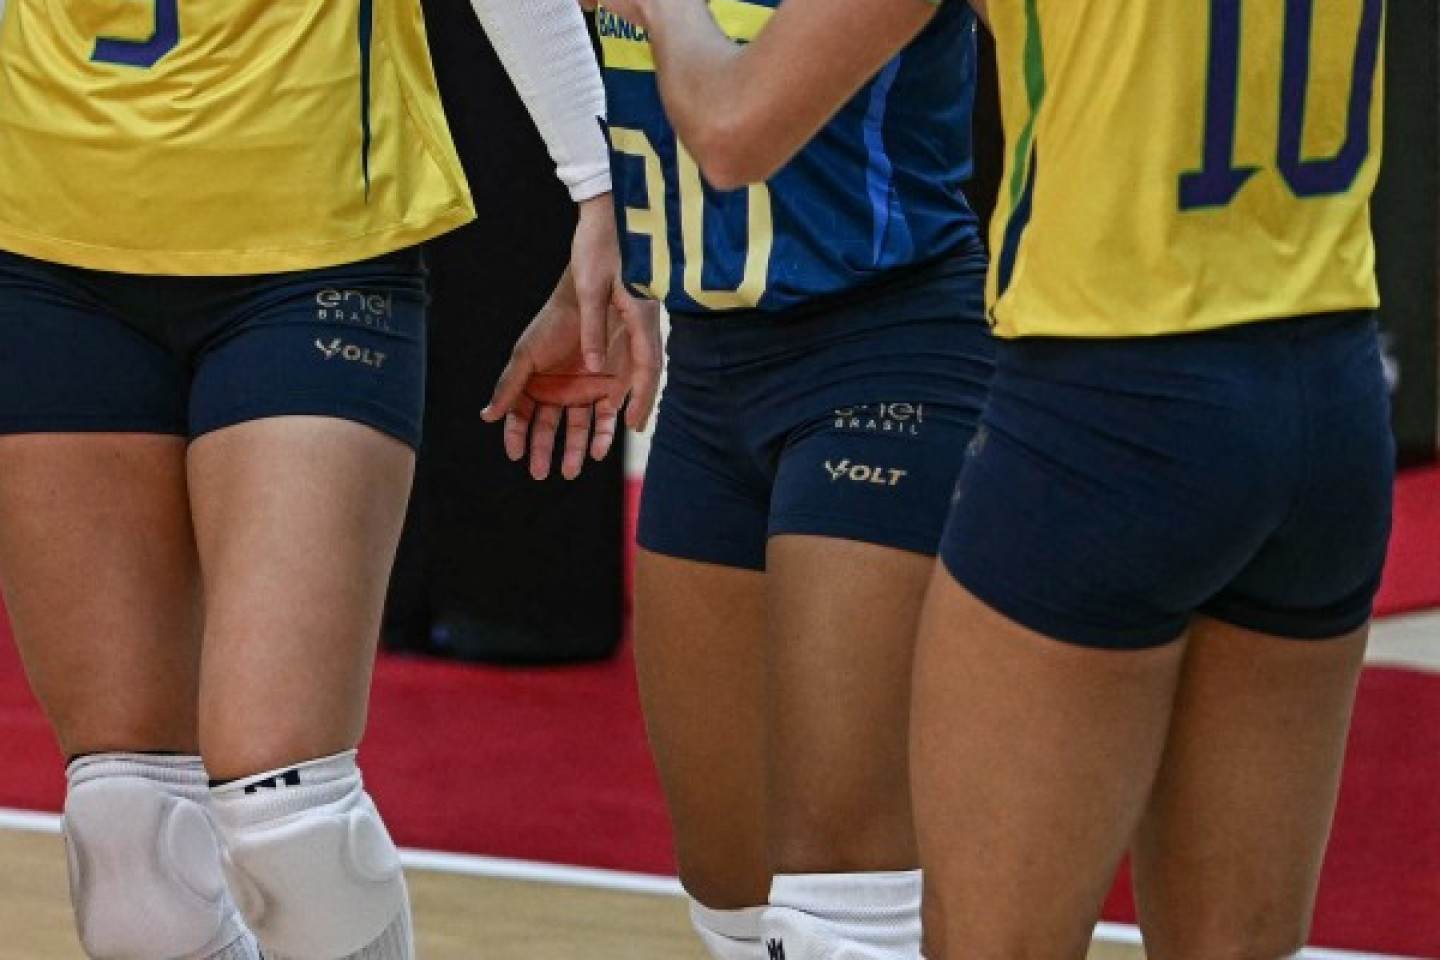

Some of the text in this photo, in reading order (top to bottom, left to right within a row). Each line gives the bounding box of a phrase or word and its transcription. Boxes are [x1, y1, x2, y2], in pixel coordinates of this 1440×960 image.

[608, 126, 774, 310] 30
[315, 338, 386, 368] VOLT
[834, 418, 919, 436] BRASIL
[824, 457, 908, 486] VOLT
